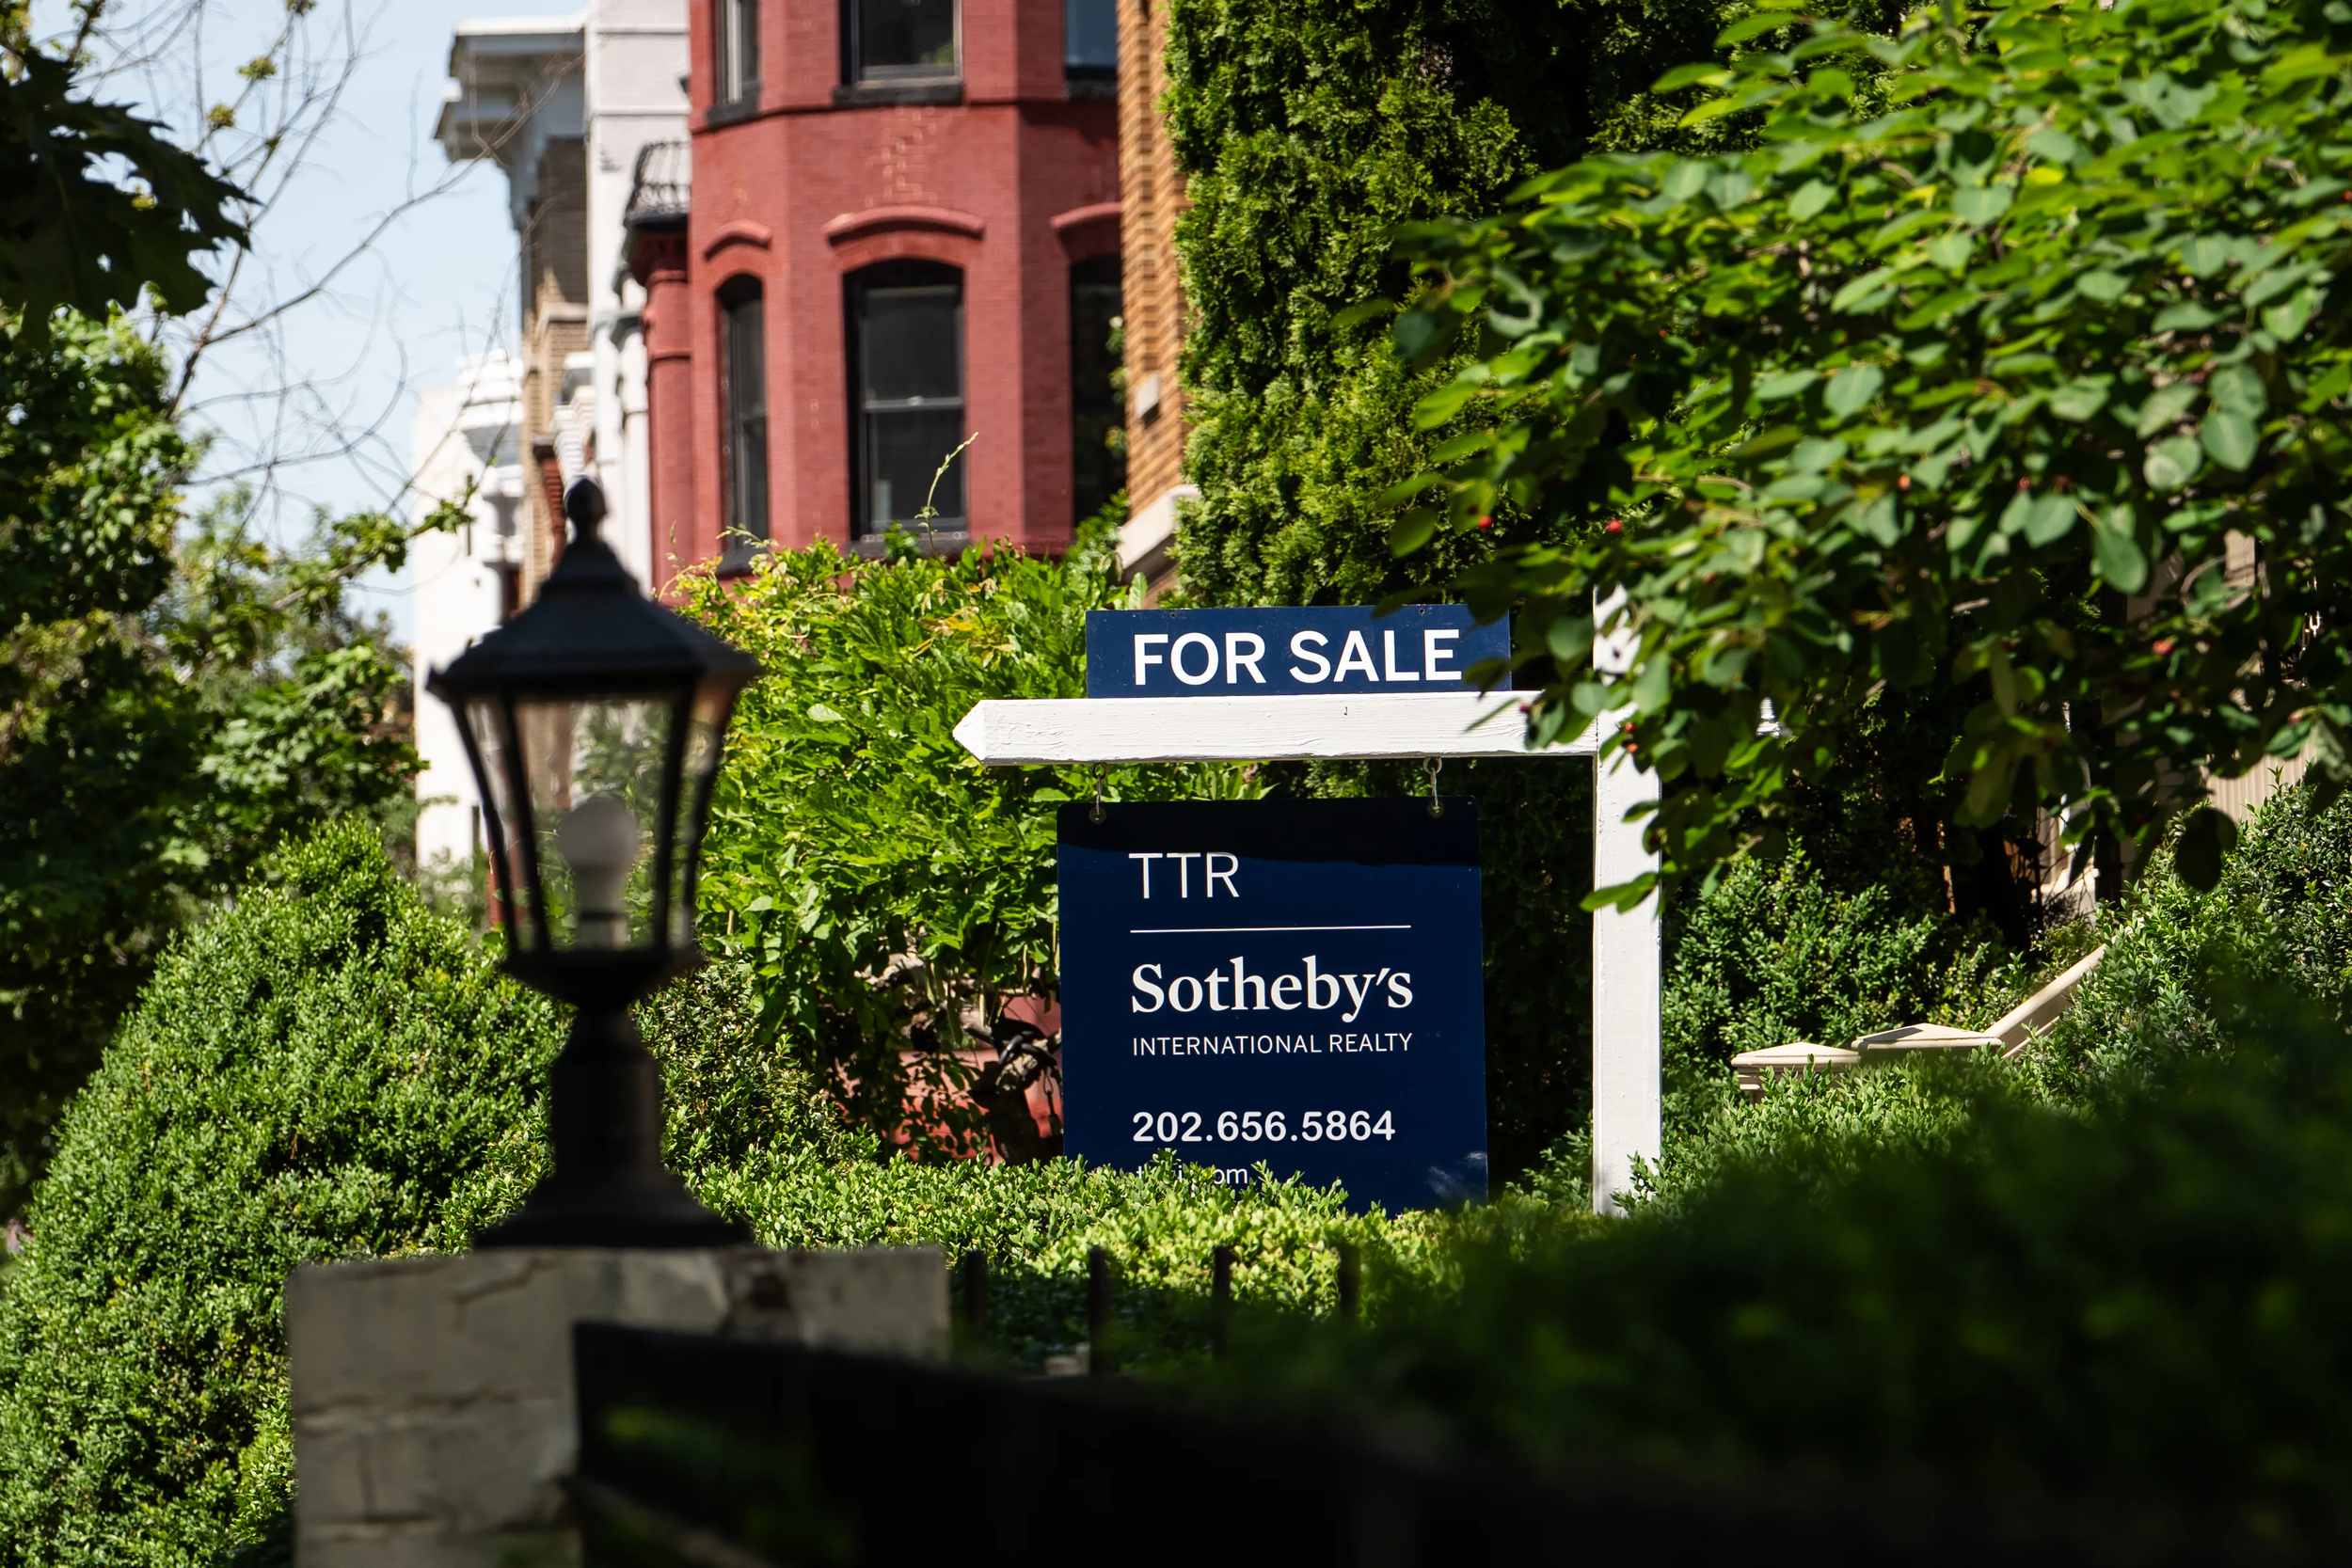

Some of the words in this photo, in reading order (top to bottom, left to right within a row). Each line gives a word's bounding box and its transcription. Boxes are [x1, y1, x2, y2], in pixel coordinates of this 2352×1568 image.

[1134, 632, 1267, 686] FOR
[1289, 629, 1462, 684] SALE
[1128, 852, 1240, 899] TTR
[1132, 955, 1413, 1023] Sotheby's
[1133, 1035, 1323, 1056] INTERNATIONAL
[1329, 1032, 1413, 1053] REALTY
[1133, 1110, 1396, 1143] 202.656.5864
